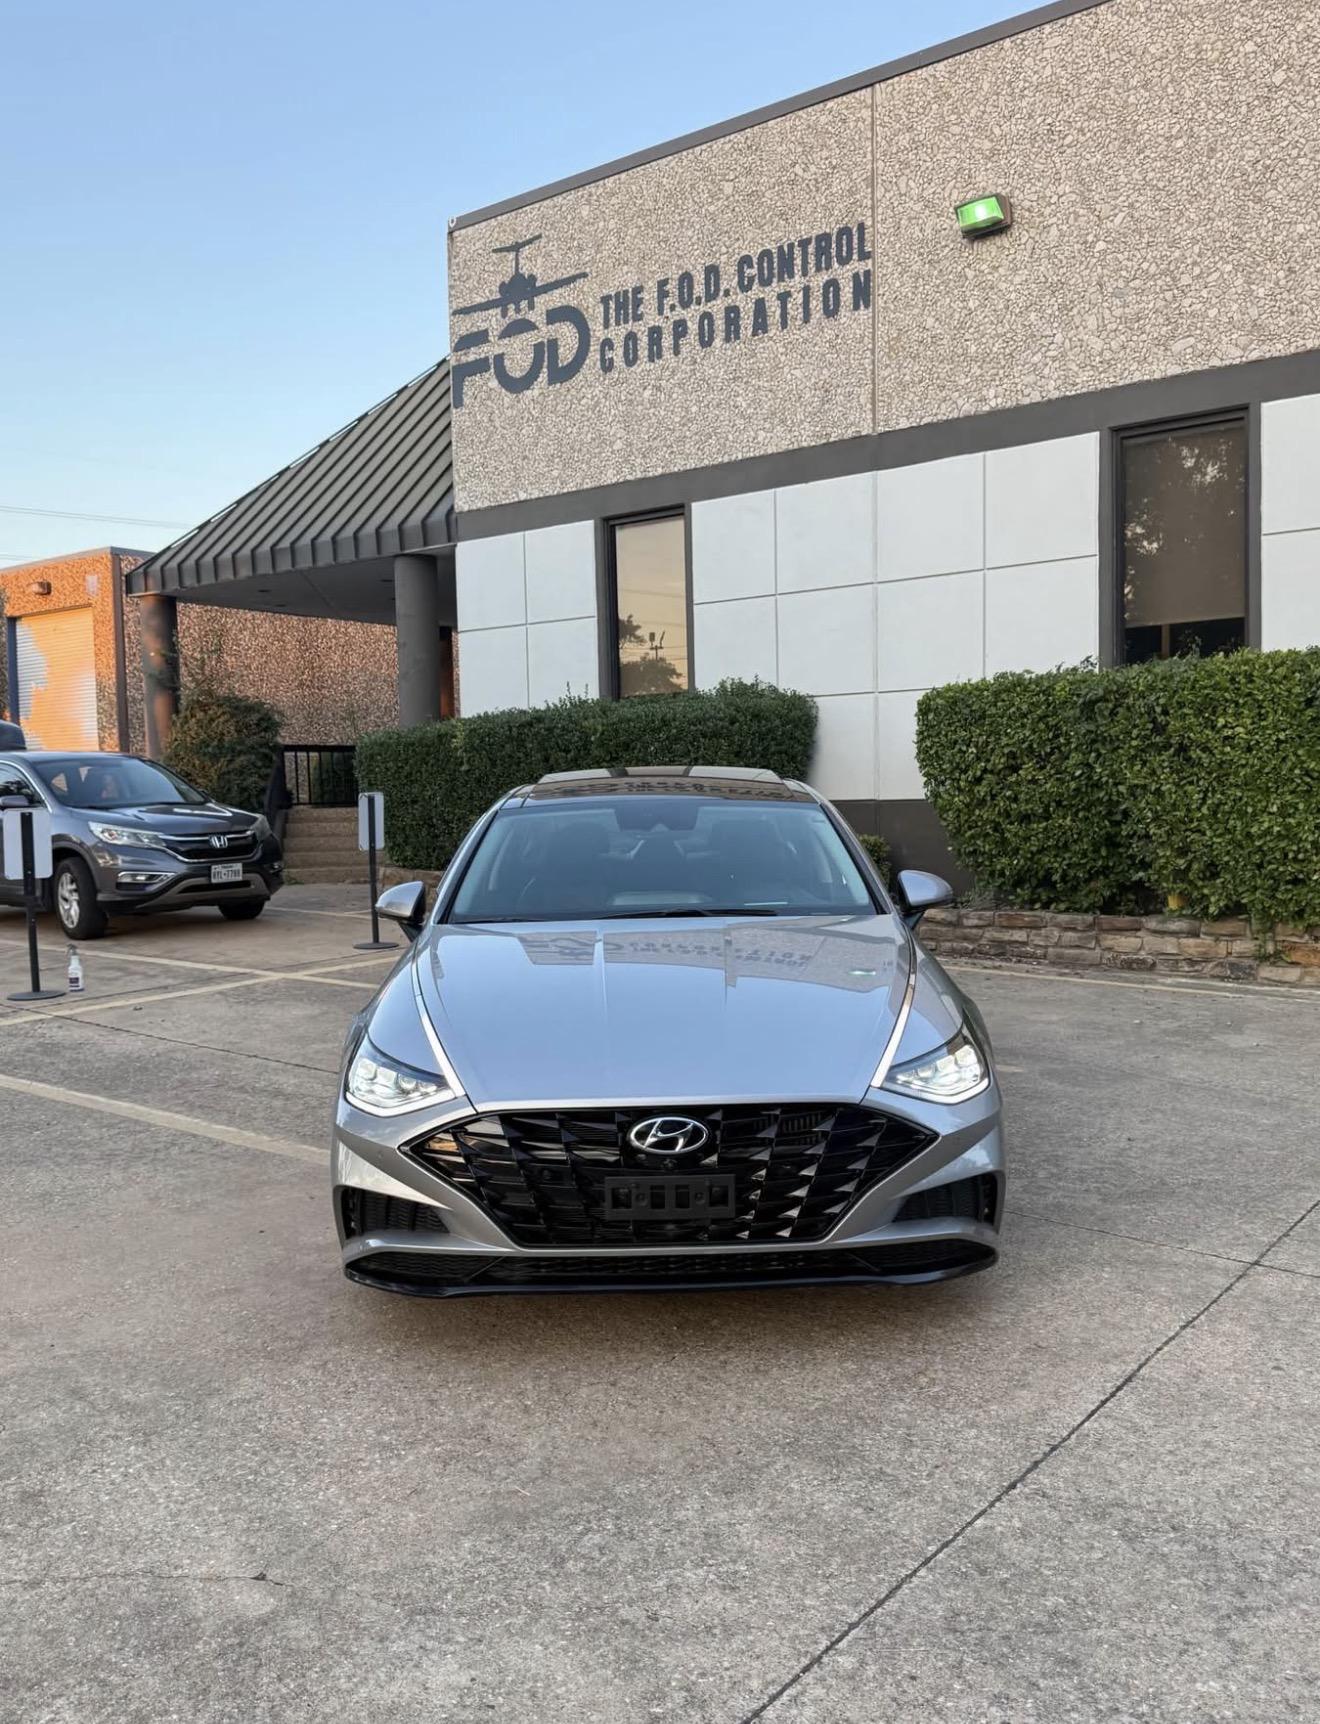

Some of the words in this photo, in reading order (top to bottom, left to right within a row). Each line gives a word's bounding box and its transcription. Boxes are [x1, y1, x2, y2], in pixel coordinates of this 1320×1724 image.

[601, 286, 644, 328] THE
[656, 265, 731, 316] F.O.D.
[737, 222, 871, 293] CONTROL
[601, 270, 871, 373] CORPORATION
[452, 304, 591, 408] FOD
